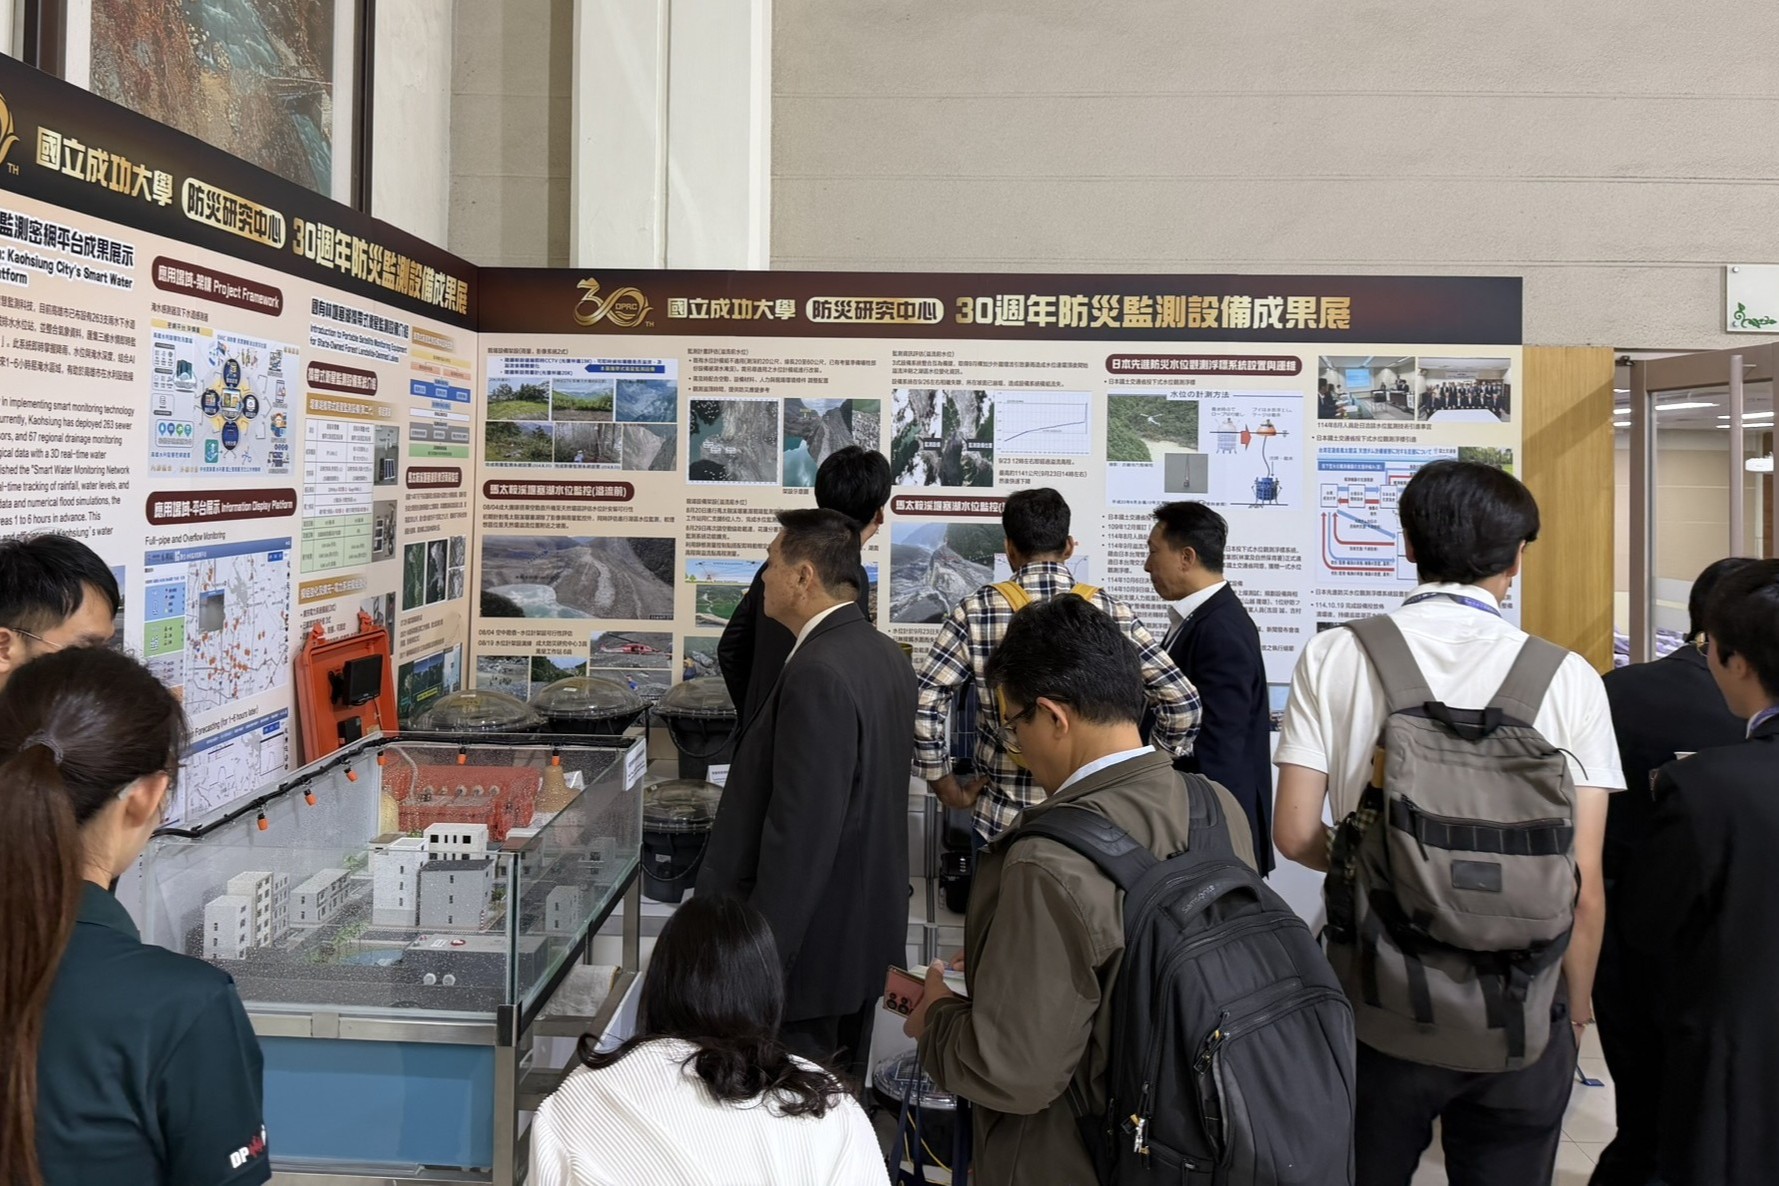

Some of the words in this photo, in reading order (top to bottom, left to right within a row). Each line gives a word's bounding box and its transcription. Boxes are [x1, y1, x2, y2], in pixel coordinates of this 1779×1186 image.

[36, 126, 174, 206] 國立成功大學
[187, 183, 283, 244] 防災研究中心
[292, 217, 468, 316] 30週年防災監測設備成果展
[7, 248, 54, 275] Kaohsiung
[56, 260, 82, 279] City's
[84, 267, 108, 284] Smart
[109, 272, 133, 289] Water
[213, 279, 242, 298] Project
[242, 287, 280, 309] Framework
[667, 297, 796, 320] 國立成功大學
[812, 299, 938, 321] 防災研究中心
[955, 294, 1351, 330] 30週年防災監測設備成果展
[1169, 391, 1230, 399] 水位の計測方法
[9, 397, 52, 411] implementing
[53, 401, 71, 411] smart
[72, 403, 103, 415] monitoring
[104, 405, 134, 417] technology
[0, 416, 27, 426] urrently,
[28, 415, 62, 428] Kaohsiung
[63, 417, 74, 427] has
[75, 418, 102, 430] deployed
[103, 420, 114, 429] 263
[115, 421, 132, 430] sewer
[0, 432, 13, 442] ors,
[15, 432, 27, 441] and
[38, 432, 64, 444] regional
[65, 433, 91, 445] drainage
[92, 434, 123, 446] monitoring
[15, 448, 29, 458] data
[31, 449, 44, 458] with
[50, 448, 59, 458] 3D
[60, 449, 89, 459] real-time
[90, 450, 107, 459] water
[0, 464, 18, 475] ished
[19, 465, 30, 475] the
[54, 465, 73, 475] Water
[74, 465, 105, 477] Monitoring
[106, 465, 130, 475] Network
[0, 482, 21, 491] l-time
[23, 481, 49, 492] tracking
[50, 481, 57, 491] of
[81, 482, 98, 490] water
[118, 481, 130, 489] and
[489, 484, 627, 498] 馬太鞍溪堰塞湖水位監控(溢流前)
[14, 498, 26, 508] and
[27, 497, 59, 508] numerical
[60, 496, 75, 506] flood
[111, 496, 121, 505] the
[221, 501, 251, 513] Information
[252, 500, 271, 512] Display
[271, 499, 293, 510] Platform
[895, 499, 1005, 514] 馬太鞍溪堰塞湖水位監控(
[19, 515, 26, 524] to
[33, 514, 51, 524] hours
[53, 513, 59, 522] in
[60, 512, 87, 522] advance.
[88, 511, 101, 521] This
[97, 526, 113, 537] water
[145, 533, 170, 546] Full-pipe
[171, 534, 182, 543] and
[183, 533, 203, 543] Overflow
[194, 719, 221, 736] Forecasting
[236, 710, 249, 724] hours
